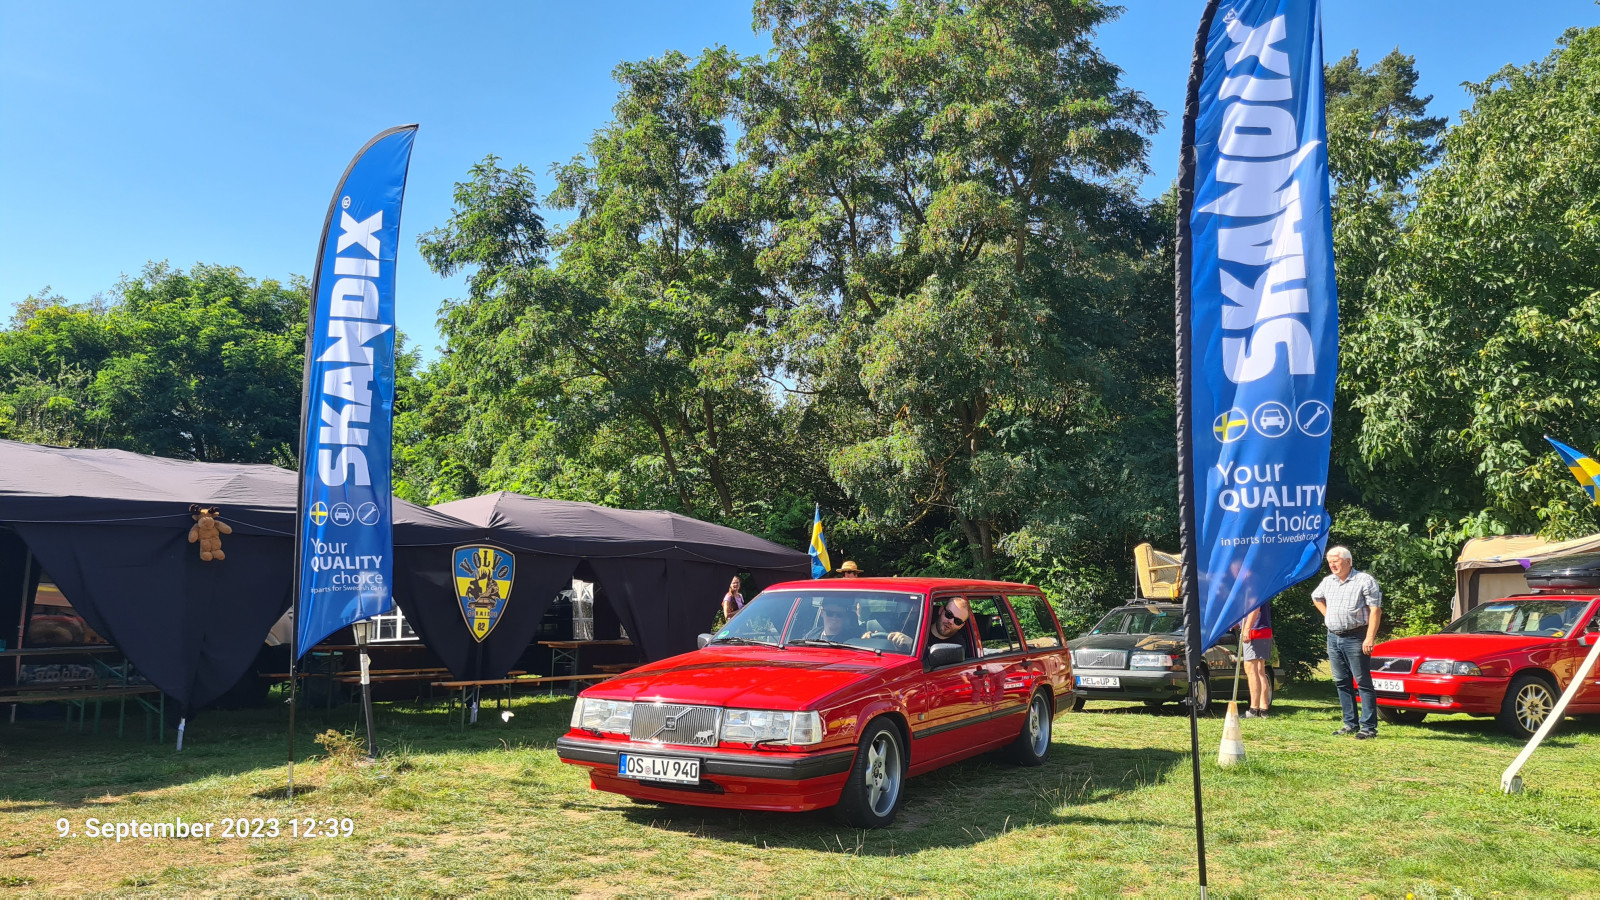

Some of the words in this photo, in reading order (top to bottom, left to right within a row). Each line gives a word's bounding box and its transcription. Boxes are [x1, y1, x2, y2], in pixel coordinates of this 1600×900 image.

[1198, 14, 1322, 383] SKANDIX
[315, 210, 392, 487] SKANDIX
[1216, 461, 1284, 486] Your
[1218, 484, 1326, 513] QUALITY
[1261, 510, 1321, 532] choice
[311, 538, 348, 555] Your
[1221, 537, 1231, 546] in
[1233, 536, 1260, 547] parts
[1262, 534, 1275, 544] for
[310, 555, 383, 572] QUALITY
[459, 550, 510, 579] VOLVO
[332, 571, 383, 585] choice
[1082, 677, 1097, 685] MEL
[1384, 681, 1401, 690] 856
[627, 757, 645, 774] OS
[652, 760, 670, 776] LV
[672, 762, 698, 779] 940
